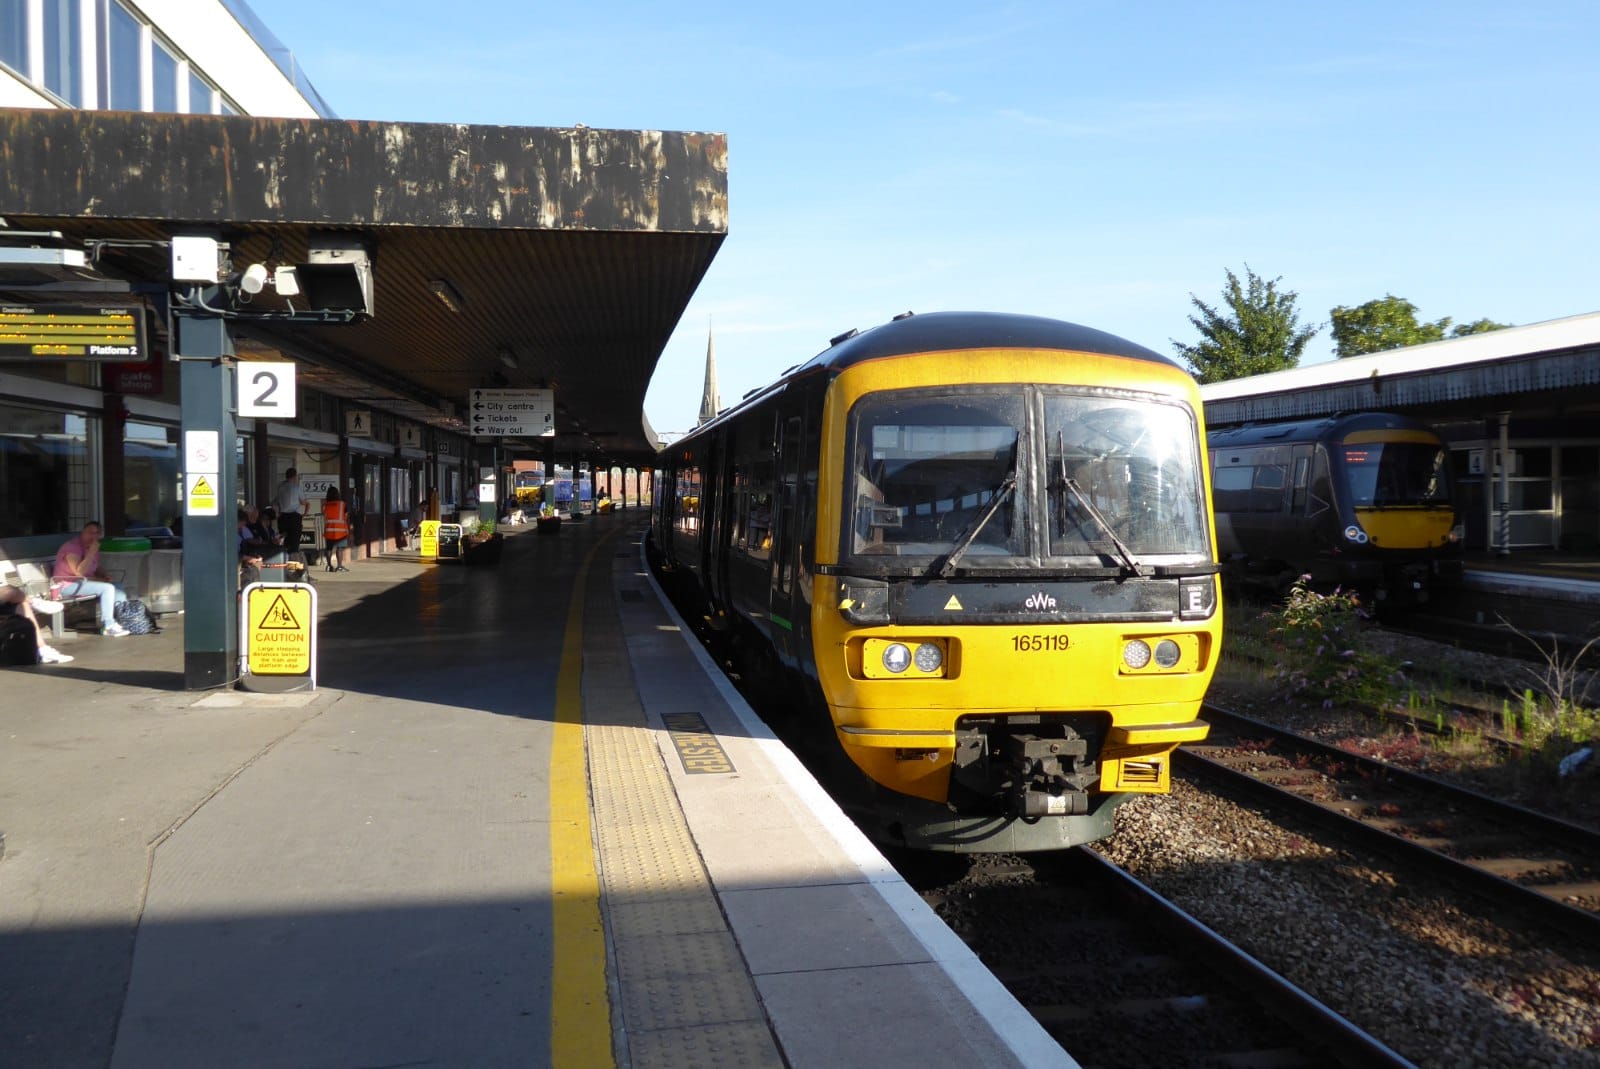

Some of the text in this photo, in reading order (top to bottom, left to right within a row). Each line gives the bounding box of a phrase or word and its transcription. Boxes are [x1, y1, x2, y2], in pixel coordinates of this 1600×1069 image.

[90, 345, 129, 355] Platform
[130, 346, 138, 355] 2
[120, 381, 152, 391] shop
[252, 371, 278, 407] 2
[487, 402, 535, 411] City centre
[487, 414, 518, 423] Tickets
[488, 426, 523, 434] Way out
[1025, 592, 1056, 610] GWR
[1189, 591, 1202, 610] E
[255, 633, 304, 642] CAUTION
[1011, 634, 1069, 652] 165119
[682, 747, 731, 773] STEP
